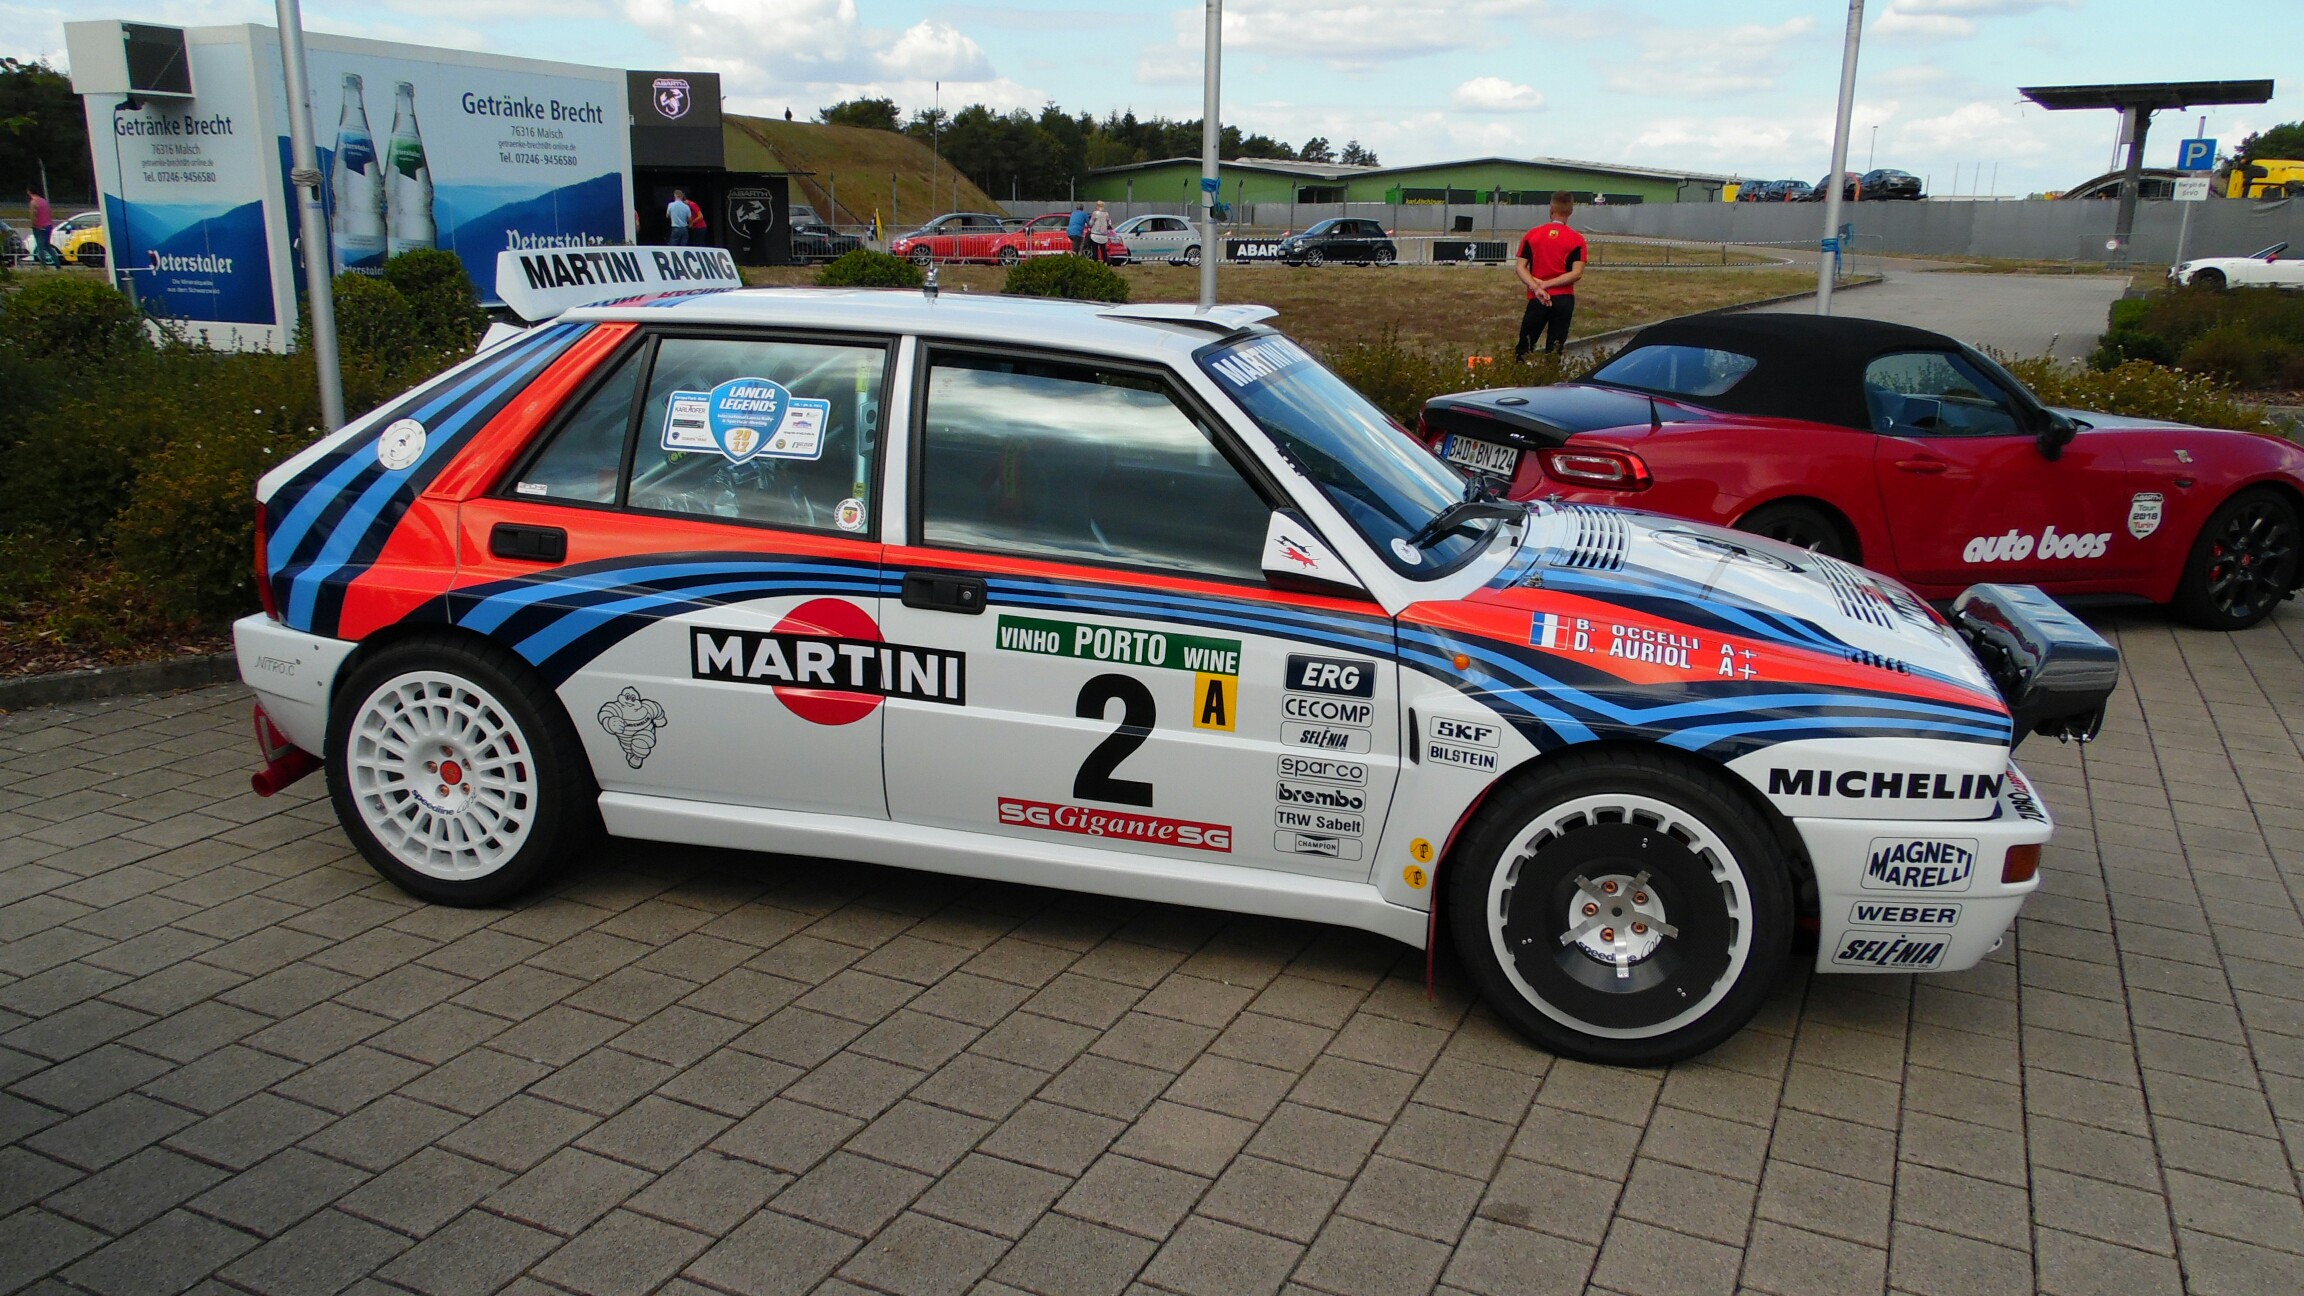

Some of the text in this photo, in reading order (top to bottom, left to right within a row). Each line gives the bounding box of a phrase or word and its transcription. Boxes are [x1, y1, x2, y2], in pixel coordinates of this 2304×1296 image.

[462, 92, 603, 124] Getränke Brecht
[115, 114, 233, 136] Getränke Brecht
[511, 125, 563, 139] 76316 Malsch
[151, 143, 201, 155] 76316 Malsch
[499, 152, 578, 166] Tel. 07246-9456580
[2185, 143, 2208, 167] P
[143, 172, 155, 182] Tel.
[1237, 243, 1279, 256] ABAR
[148, 249, 232, 276] Peterstaler
[520, 250, 737, 289] MARTINI RACING
[719, 398, 778, 412] LEGENDS
[729, 386, 776, 400] LANCIA
[733, 429, 752, 441] 20
[1449, 436, 1515, 473] BAD BN 124
[2133, 512, 2158, 520] 2018
[1963, 525, 2112, 563] auto boos
[1576, 618, 1597, 632] B.
[1612, 624, 1699, 650] OCCELLI
[1000, 626, 1238, 673] VINHO PORTO WINE
[1573, 632, 1758, 680] D. AURIOL A+
[697, 633, 958, 699] MARTINI
[1301, 662, 1360, 690] ERG
[1201, 679, 1226, 726] A
[1285, 699, 1370, 723] CECOMP
[1073, 673, 1157, 808] 2
[1437, 721, 1492, 741] SKF
[1281, 757, 1362, 779] sparco
[1430, 745, 1495, 769] BILSTEIN
[1768, 768, 2004, 799] MICHELIN
[411, 789, 454, 815] speedline
[1279, 783, 1363, 809] brembo
[1278, 811, 1361, 833] TRW Sabelt
[1297, 839, 1337, 851] CHAMPION
[1869, 841, 1972, 867] MAGNETI
[1869, 864, 1972, 888] MARELLI
[1856, 905, 1956, 923] WEBER
[1578, 941, 1637, 962] speede
